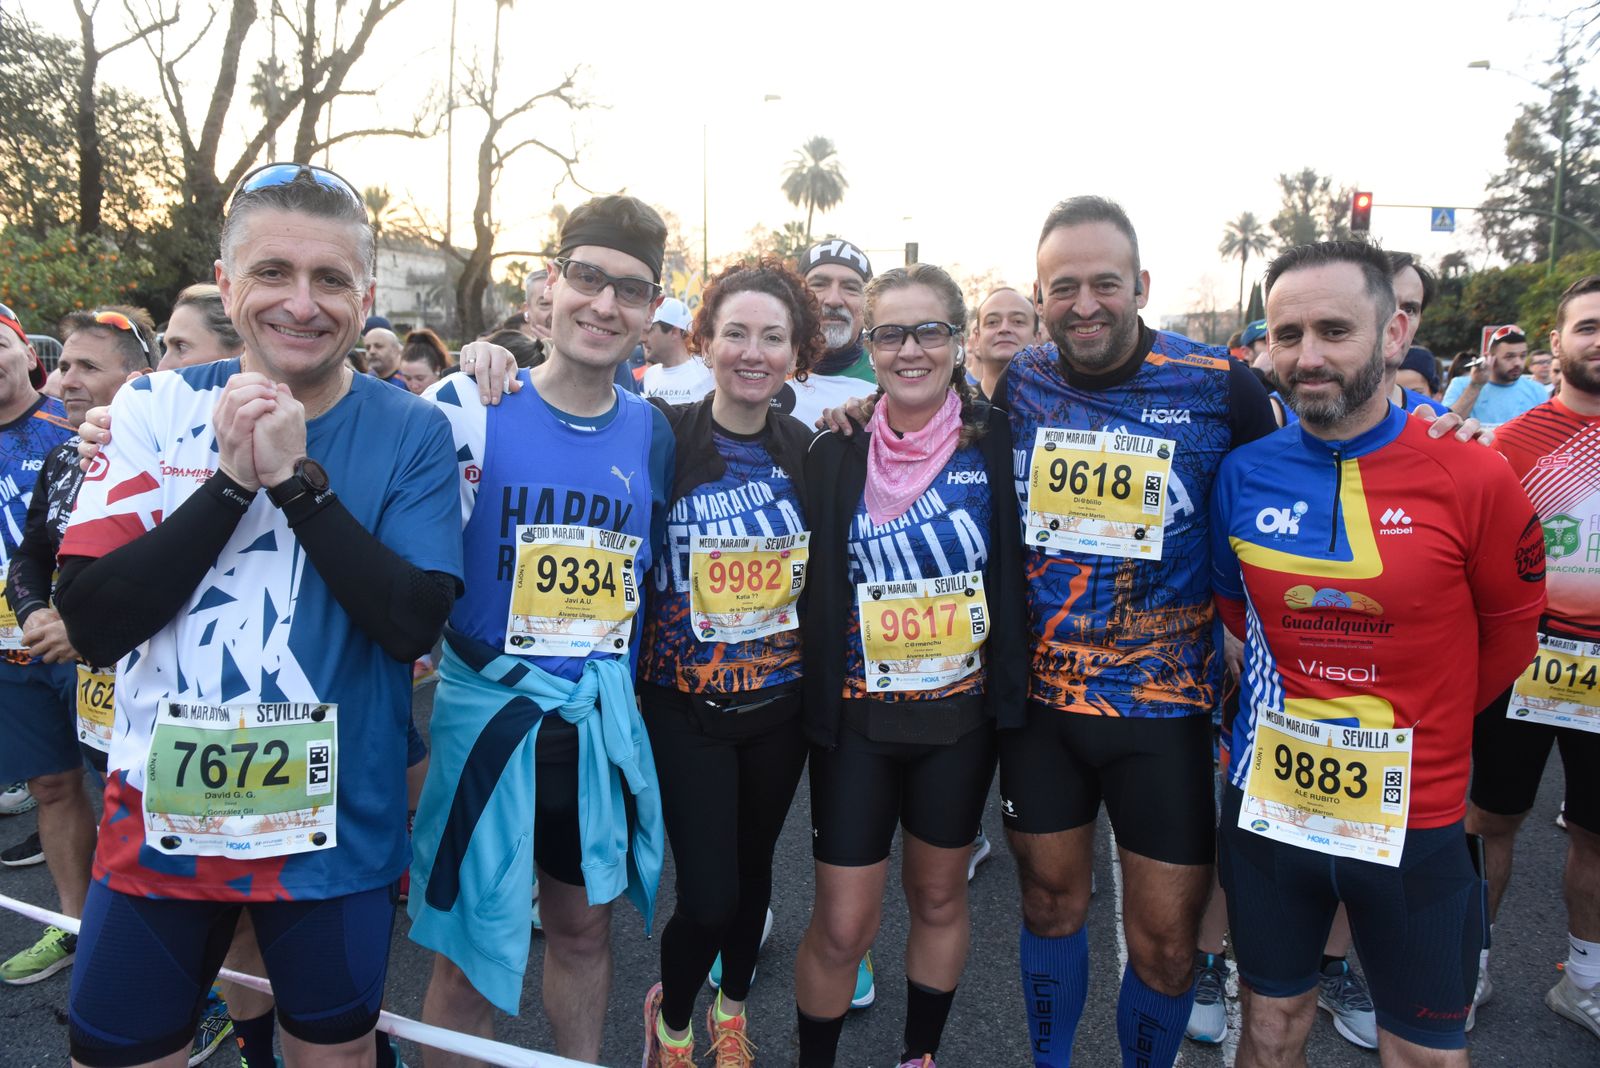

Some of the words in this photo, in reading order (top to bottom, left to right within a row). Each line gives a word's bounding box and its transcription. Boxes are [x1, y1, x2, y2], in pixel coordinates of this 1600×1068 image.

[1140, 408, 1192, 424] HOKA
[1044, 431, 1065, 443] MEDIO
[1065, 431, 1097, 446] MARATÓN
[1113, 434, 1153, 454] SEVILLA
[21, 460, 45, 471] HO
[947, 471, 988, 485] HOKA
[1048, 457, 1132, 500] 9618
[500, 486, 633, 538] HAPPY
[526, 527, 549, 539] MEDIO
[552, 527, 585, 541] MARATÓN
[599, 530, 628, 550] SEVILLA
[1379, 527, 1413, 536] mobel
[699, 537, 719, 548] MEDIO
[720, 537, 750, 548] MARATÓN
[765, 535, 796, 550] SEVILLA
[1078, 538, 1098, 547] HOKA
[536, 554, 617, 598] 9334
[709, 559, 781, 594] 9982
[866, 585, 886, 596] MEDIO
[887, 582, 918, 594] MARATÓN
[934, 575, 968, 594] SEVILLA
[880, 603, 957, 642] 9617
[1282, 615, 1395, 636] Guadalquivir
[570, 640, 591, 648] HOKA
[1549, 637, 1578, 651] MARATÓN
[1298, 658, 1376, 682] Visol
[1532, 655, 1597, 690] 1014
[81, 678, 115, 710] 162
[190, 704, 230, 722] MARATÓN
[256, 703, 310, 723] SEVILLA
[1265, 709, 1285, 729] MEDIO
[1286, 718, 1320, 738] MARATÓN
[1342, 729, 1389, 749] SEVILLA
[173, 739, 290, 788] 7672
[1274, 743, 1368, 799] 9883
[205, 791, 231, 800] David
[233, 791, 244, 799] G.
[245, 791, 256, 799] G.
[1294, 788, 1308, 798] ALE
[1309, 793, 1341, 805] RUBITO
[207, 808, 241, 816] González
[226, 841, 251, 850] HOKA
[1306, 834, 1331, 846] HOKA
